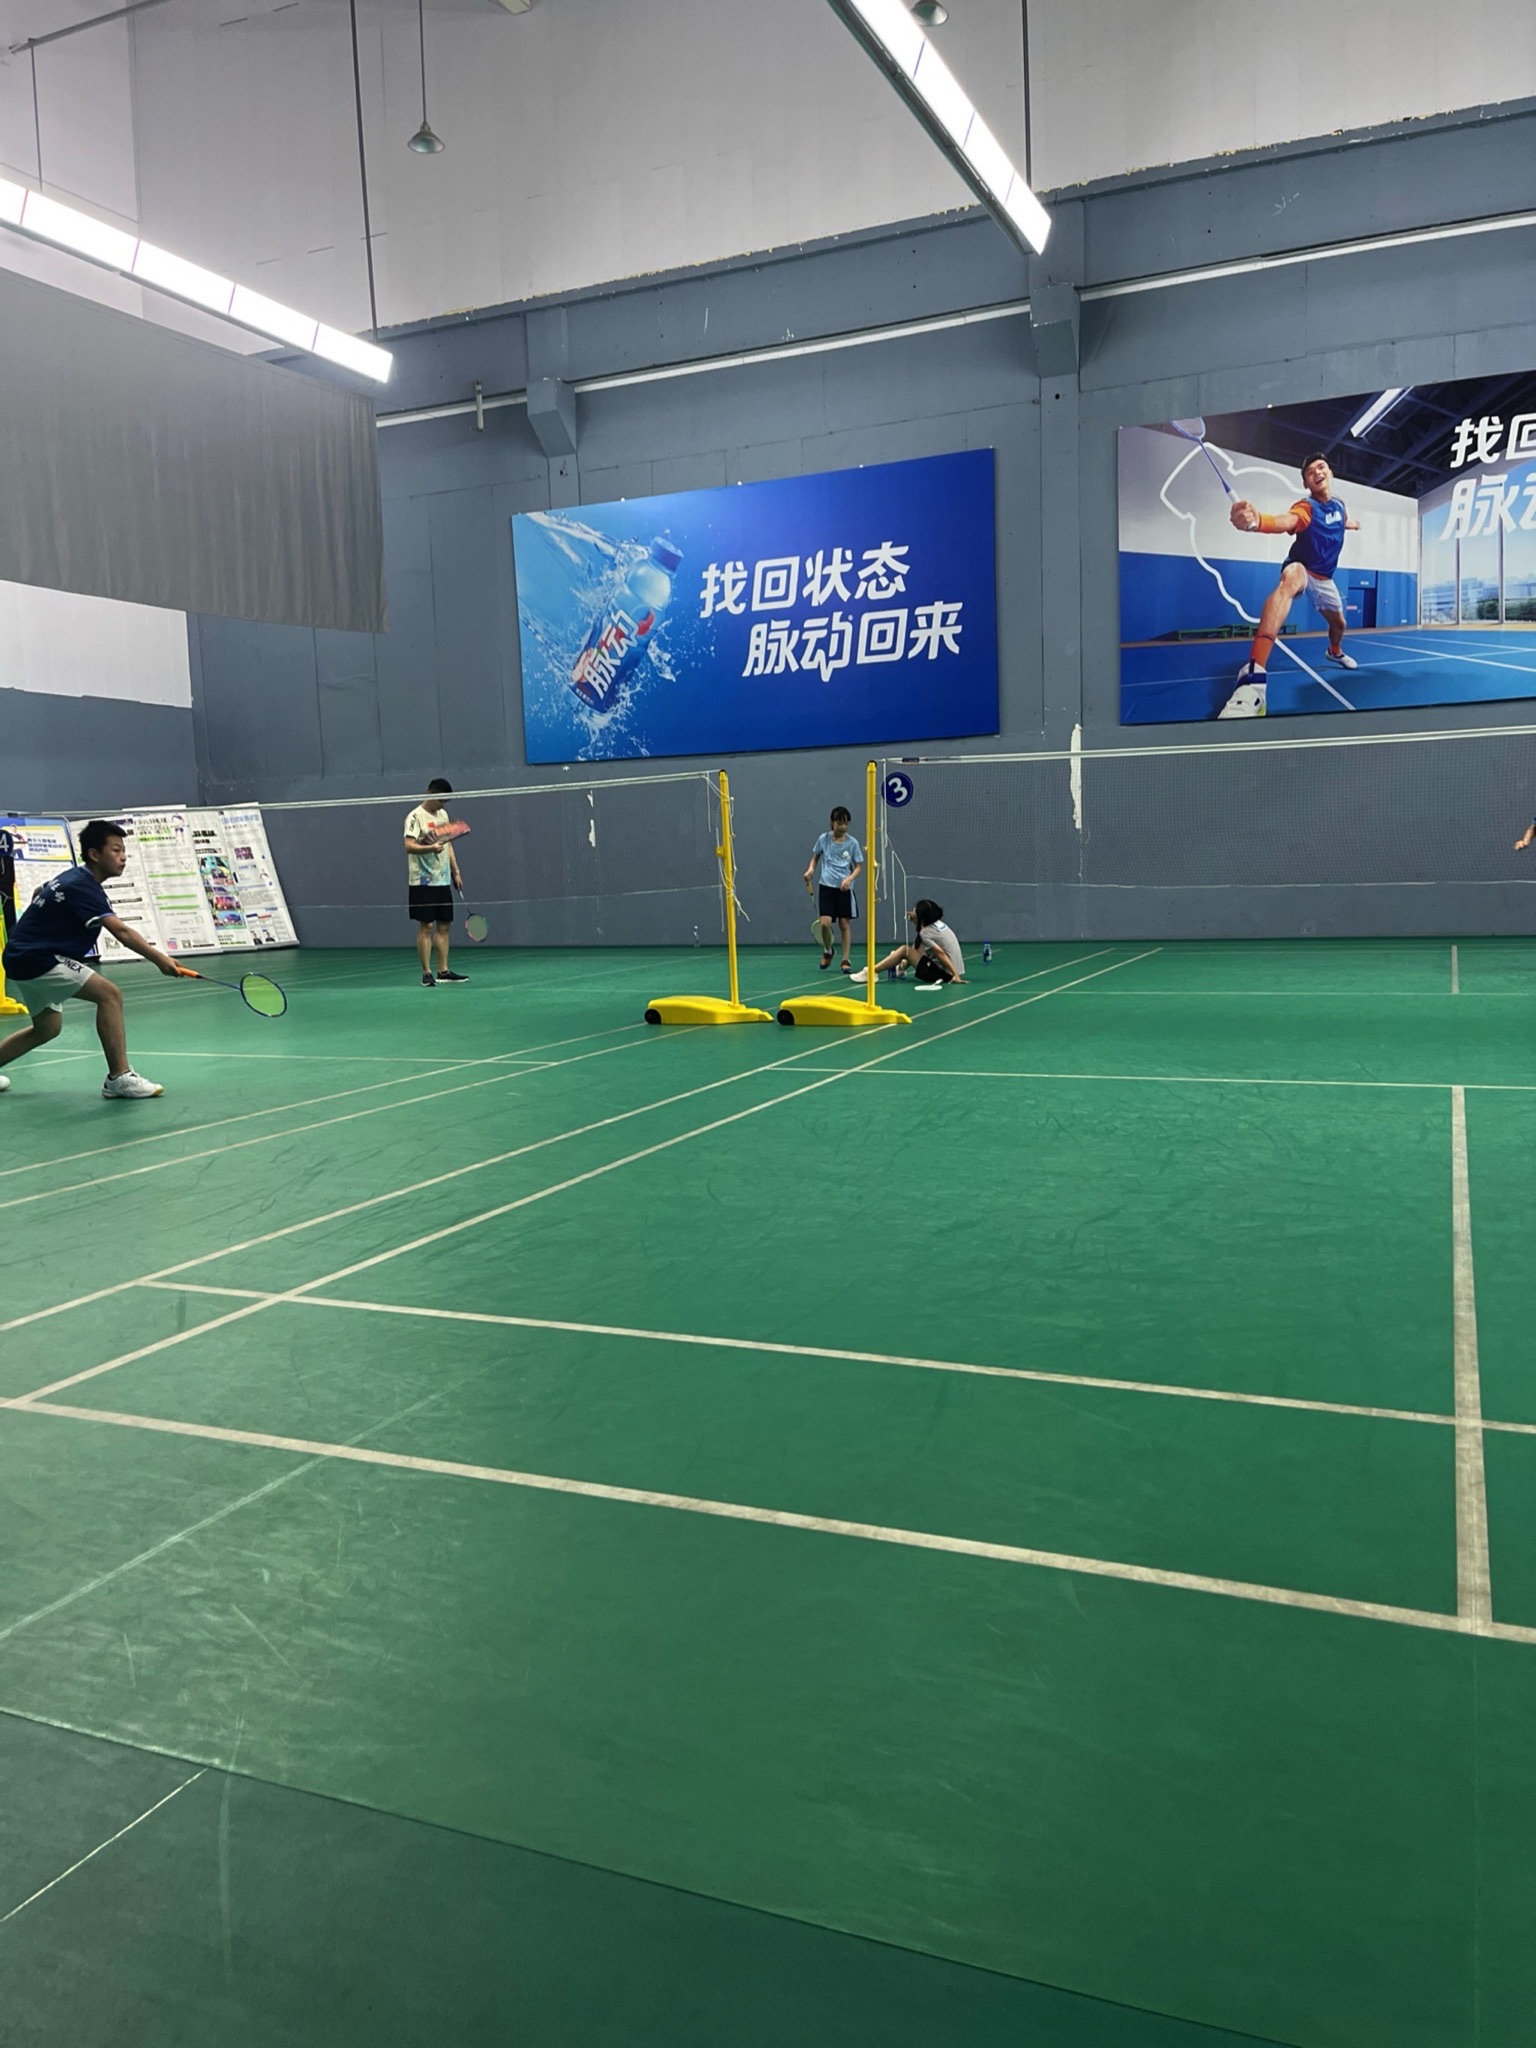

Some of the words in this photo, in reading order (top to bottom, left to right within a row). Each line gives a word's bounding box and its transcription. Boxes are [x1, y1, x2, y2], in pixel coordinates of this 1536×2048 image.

[1449, 412, 1536, 468] 找回
[700, 541, 910, 618] 找回状态
[582, 608, 640, 700] 脉动
[741, 601, 963, 682] 脉动回来
[888, 777, 908, 803] 3
[0, 833, 9, 852] 4
